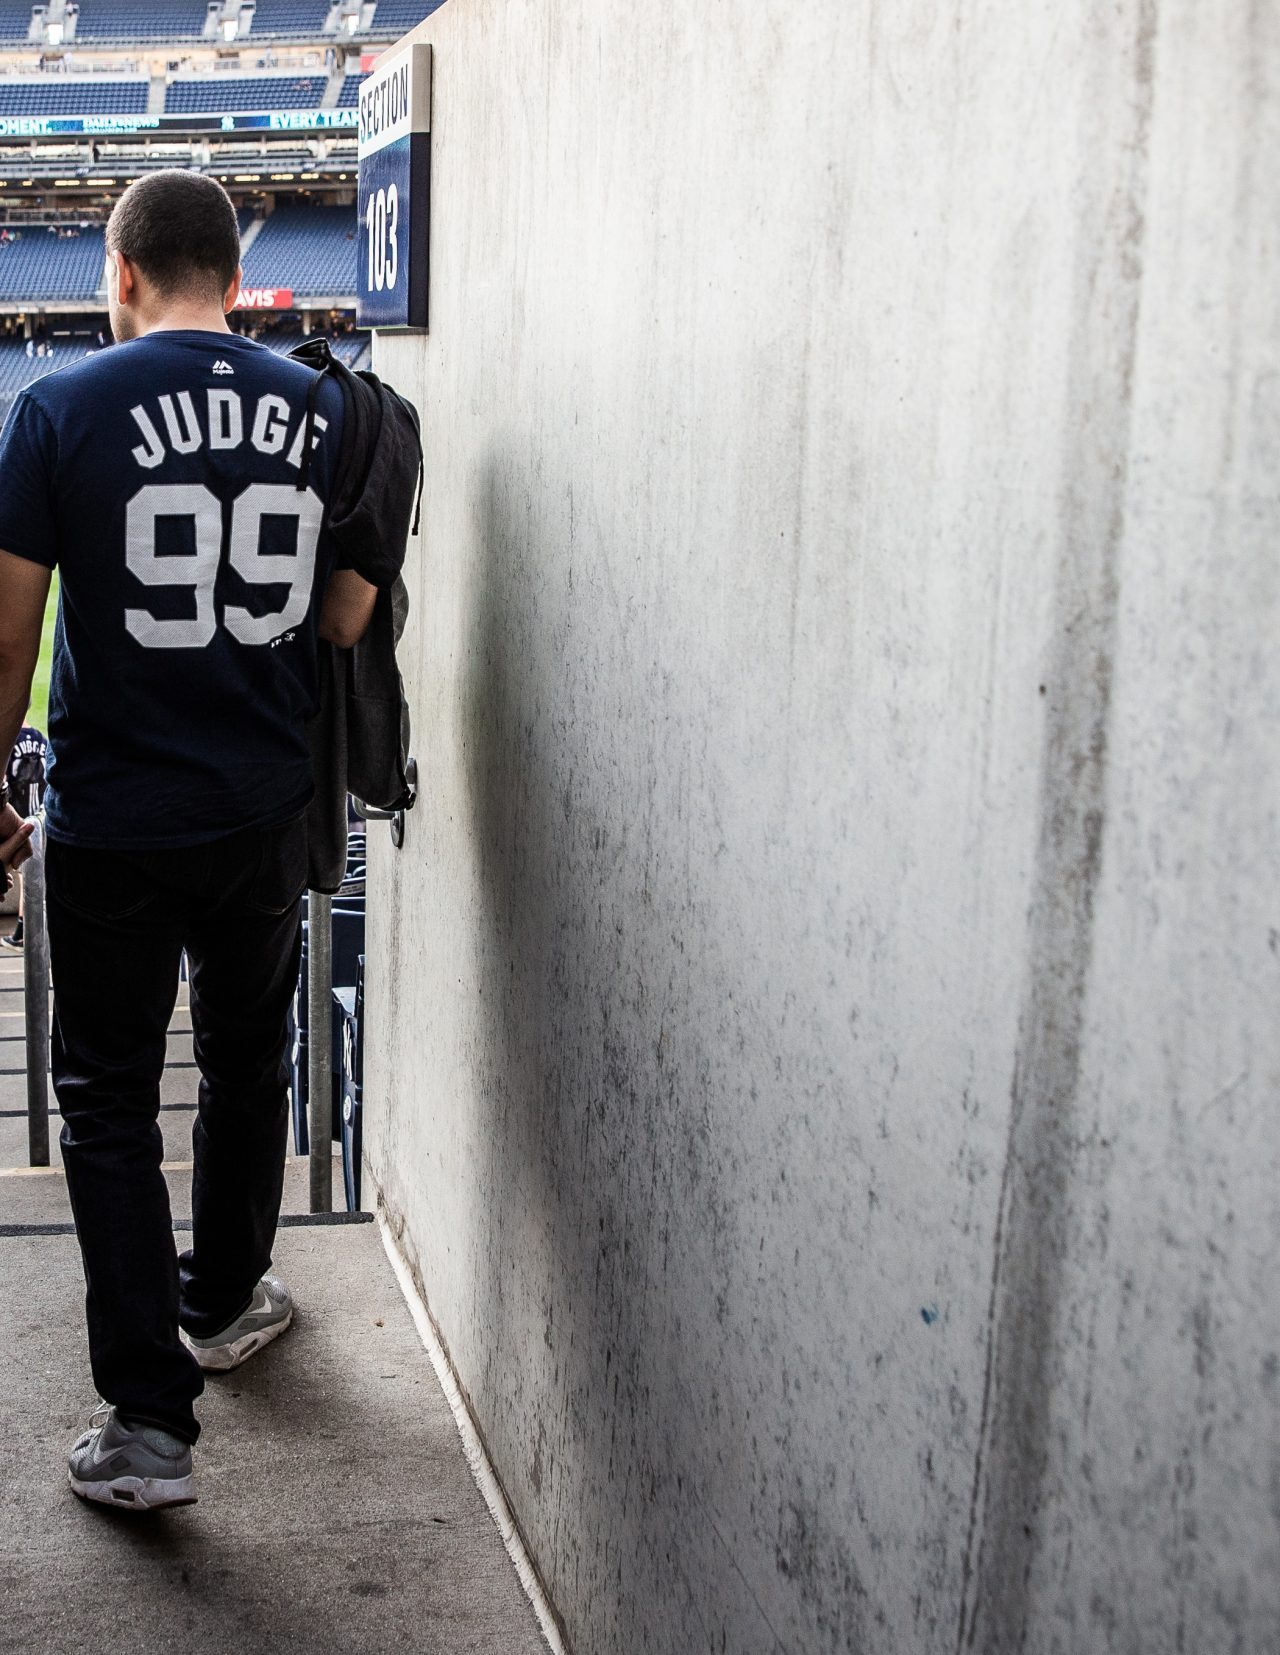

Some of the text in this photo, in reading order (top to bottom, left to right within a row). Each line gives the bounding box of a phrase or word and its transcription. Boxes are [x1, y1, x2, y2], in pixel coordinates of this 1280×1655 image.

[270, 113, 321, 128] EVERY
[360, 63, 408, 144] SECTION
[367, 184, 398, 292] 103
[234, 289, 275, 307] AVIS
[124, 482, 325, 648] 99
